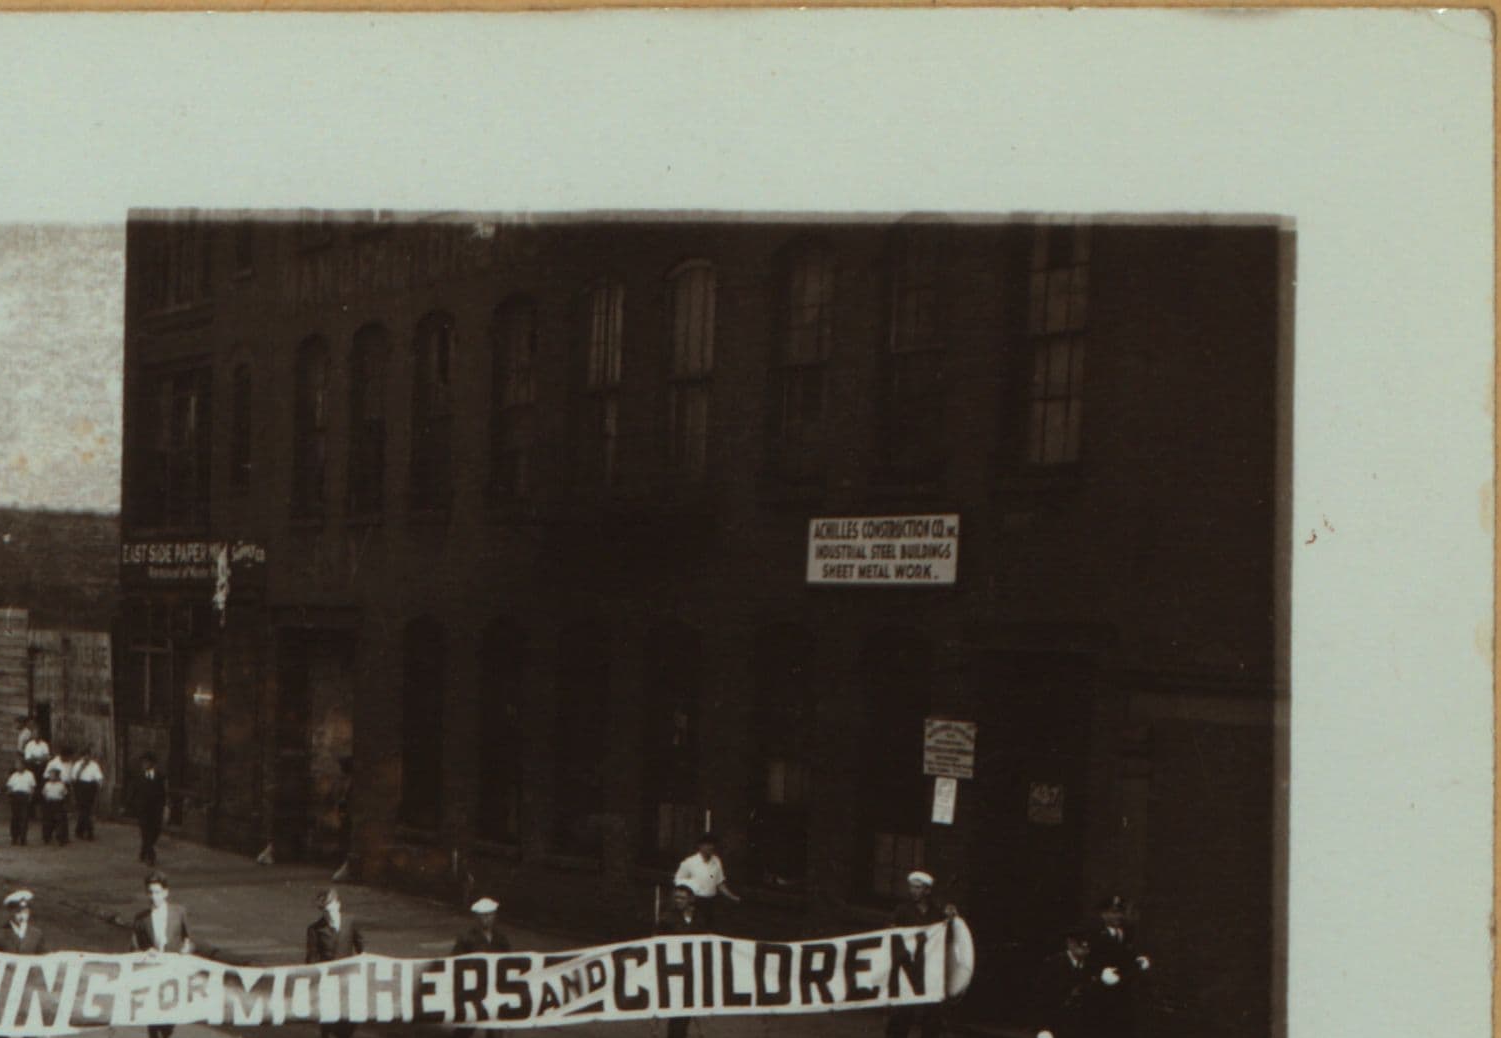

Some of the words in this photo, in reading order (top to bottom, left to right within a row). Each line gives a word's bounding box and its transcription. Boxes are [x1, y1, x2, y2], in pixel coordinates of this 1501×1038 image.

[871, 543, 896, 560] STEEL
[901, 543, 952, 560] BUILDINGS
[822, 563, 854, 579] SHEET
[858, 563, 890, 579] METAL
[130, 970, 210, 1022] FOR
[223, 956, 533, 1025] MOTHERS
[540, 958, 607, 1015] AND
[613, 932, 928, 1013] CHILDREN
